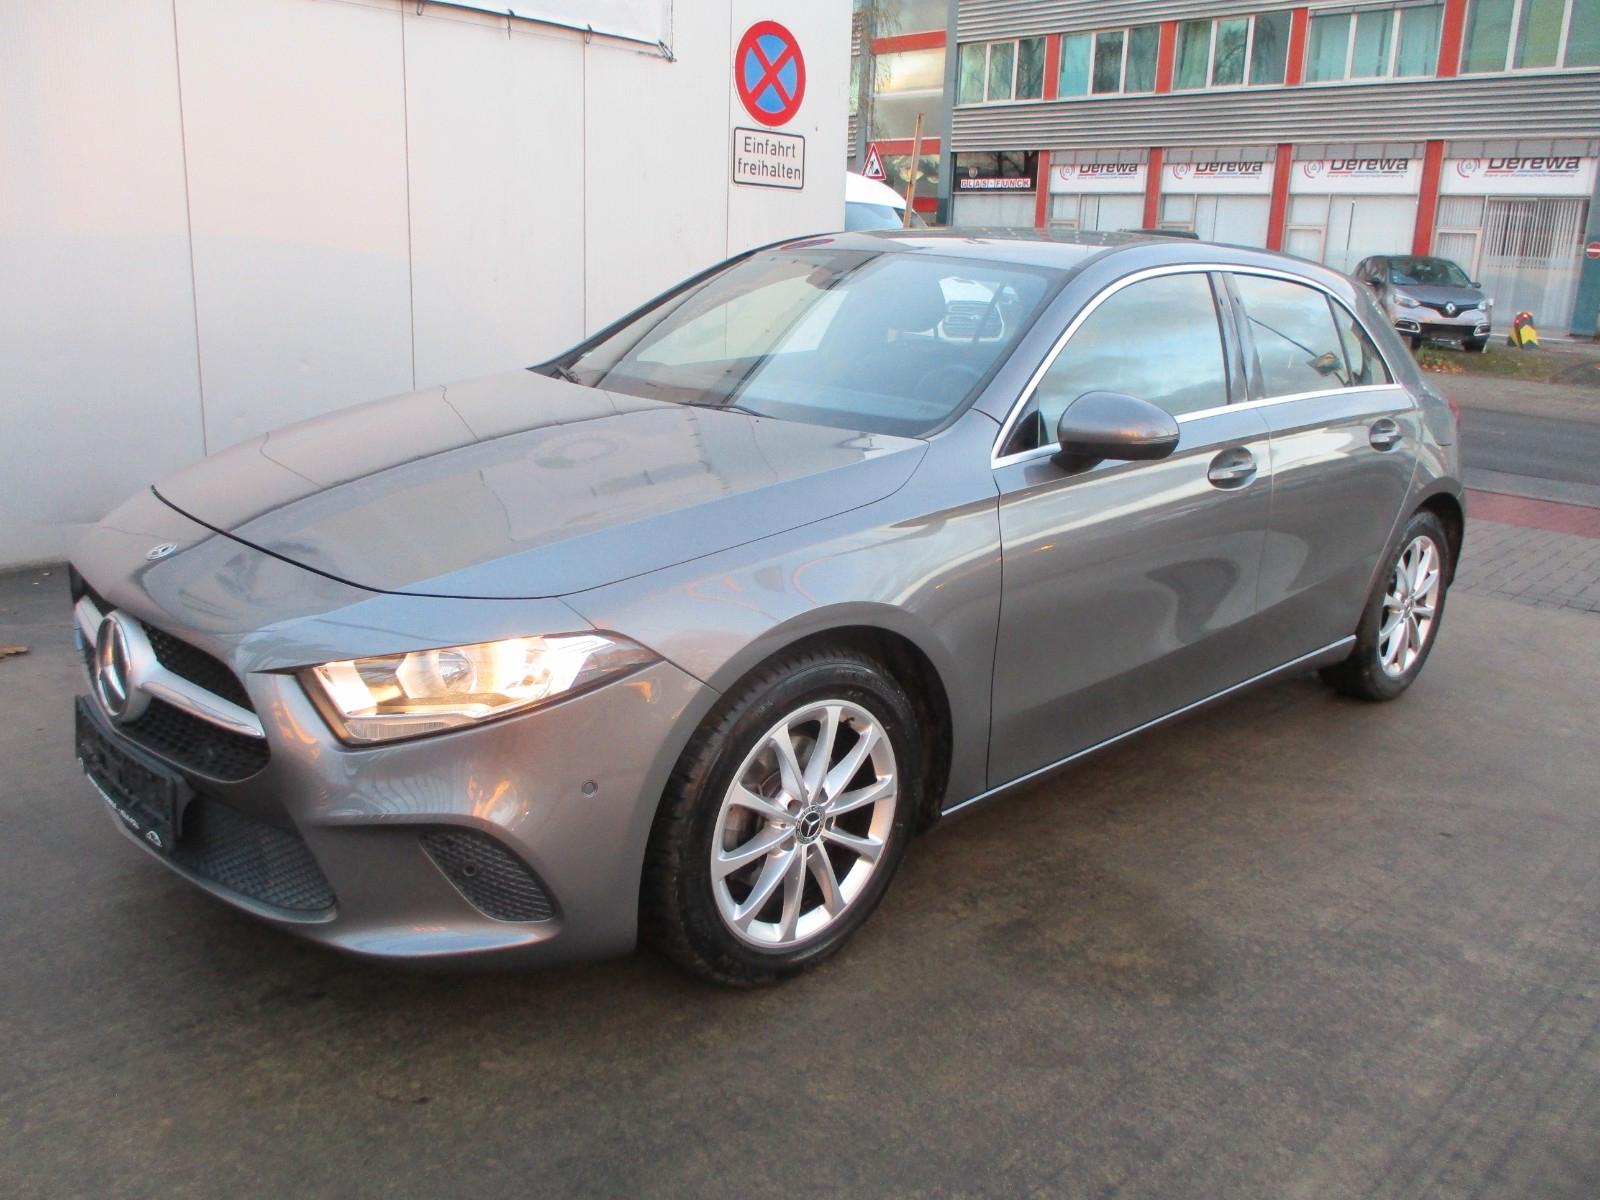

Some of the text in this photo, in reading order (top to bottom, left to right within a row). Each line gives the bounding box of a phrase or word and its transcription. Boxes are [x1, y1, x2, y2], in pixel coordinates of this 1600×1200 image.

[744, 136, 796, 158] Einfahrt
[737, 157, 801, 180] freihalten
[1195, 161, 1264, 173] Derewa
[1330, 158, 1409, 171] Derewa
[1487, 156, 1580, 170] Derewa
